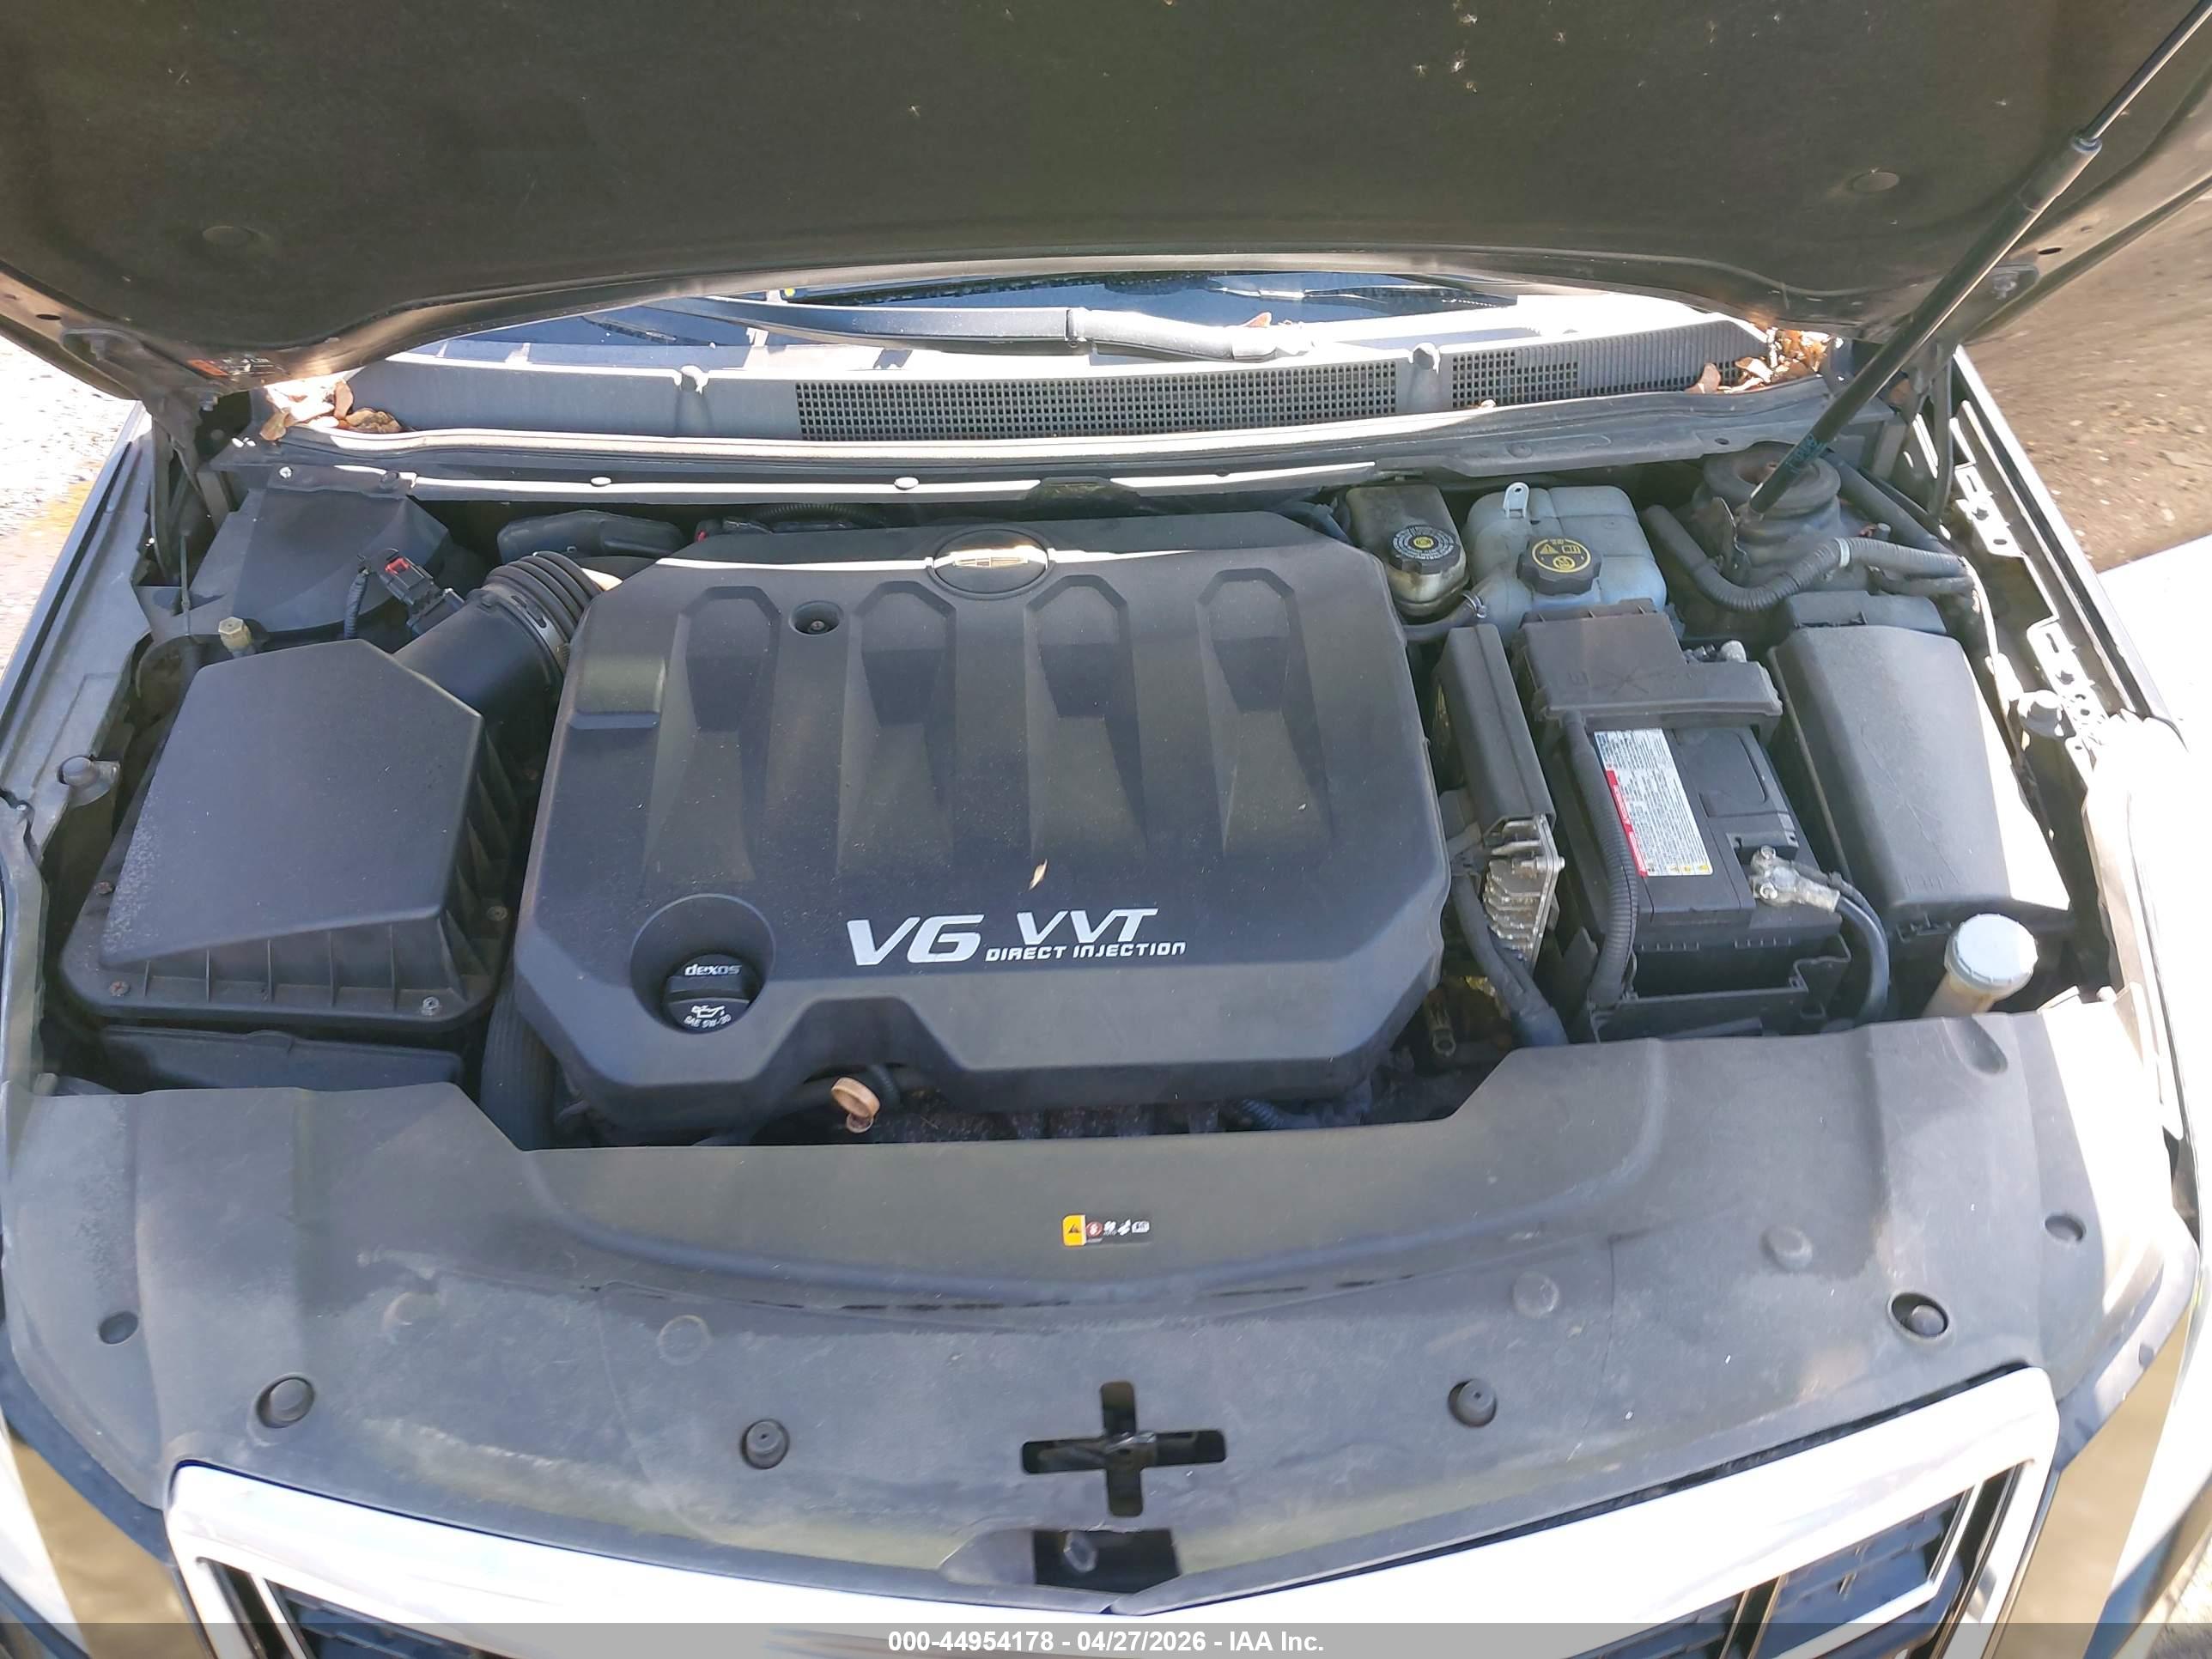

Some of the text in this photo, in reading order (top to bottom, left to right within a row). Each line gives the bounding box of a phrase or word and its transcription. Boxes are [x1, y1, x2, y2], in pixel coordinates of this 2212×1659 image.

[846, 908, 1158, 965] V6 VVT
[984, 941, 1186, 962] DIRECT INJECTION
[684, 963, 742, 975] dexos
[684, 1015, 702, 1028] SAE
